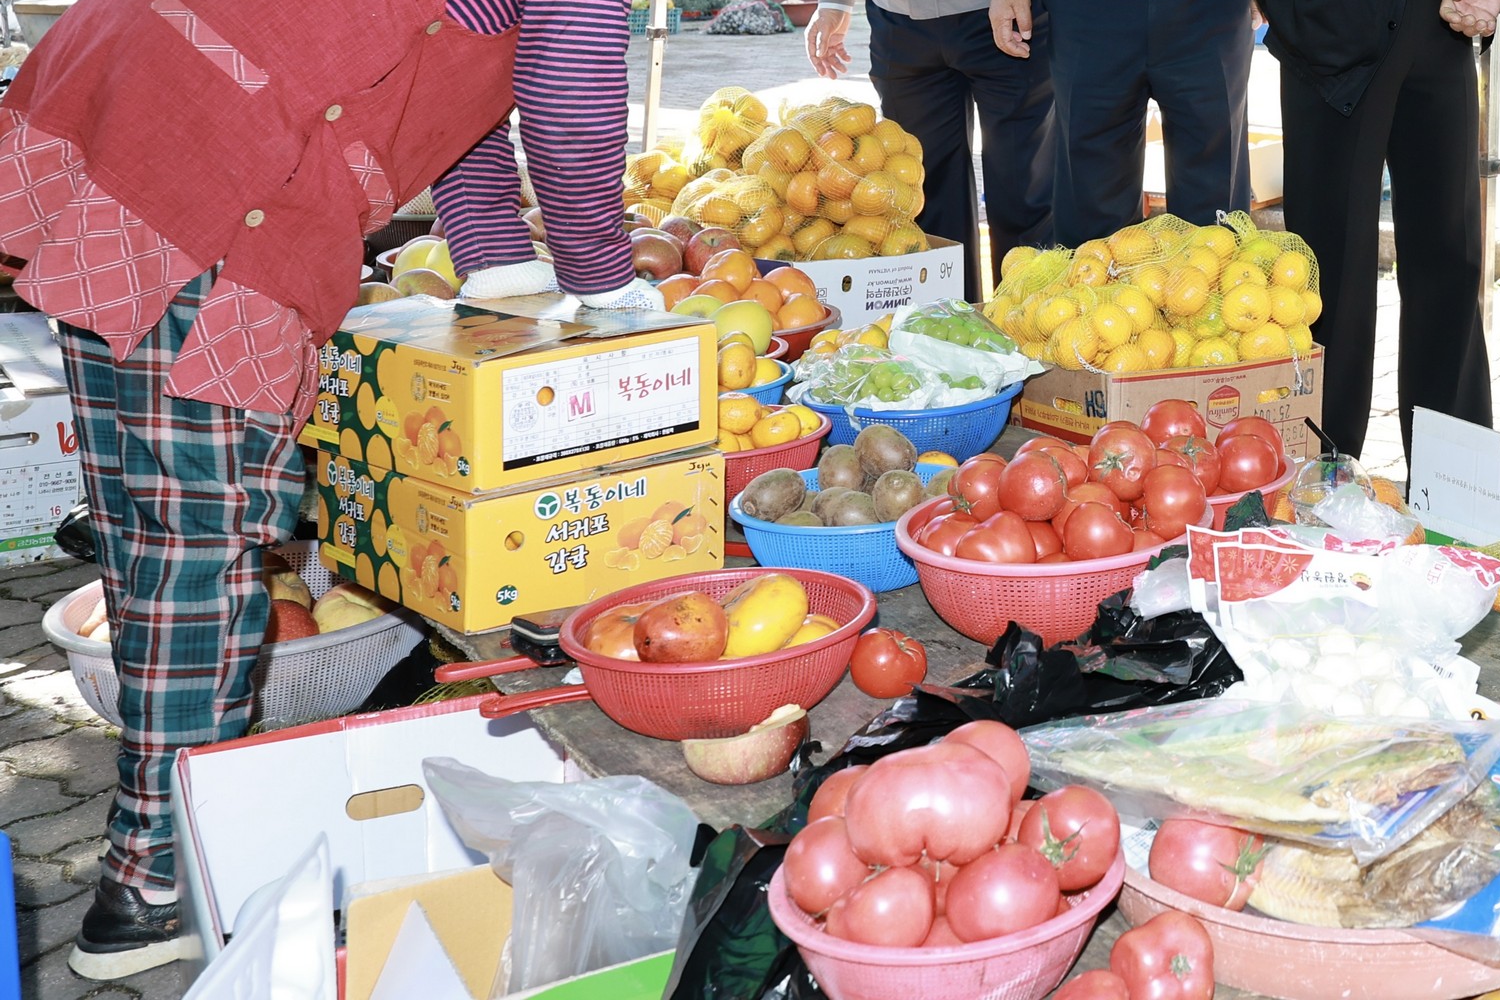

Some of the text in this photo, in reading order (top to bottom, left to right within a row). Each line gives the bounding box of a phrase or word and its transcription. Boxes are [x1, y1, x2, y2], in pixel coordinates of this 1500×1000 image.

[867, 276, 912, 287] www.jinwon.kr
[940, 262, 953, 279] A6
[866, 285, 913, 299] (주)진원무역
[320, 345, 361, 375] 복동이네
[319, 375, 349, 397] 서귀포
[618, 367, 691, 401] 복동이네
[319, 400, 340, 424] 감귤
[569, 392, 592, 416] M
[1209, 406, 1238, 419] Sumifru
[457, 460, 470, 475] 5kg
[338, 466, 374, 500] 복동이네
[564, 477, 648, 513] 복동이네
[50, 505, 61, 517] 16
[339, 496, 365, 522] 서귀포
[338, 521, 357, 548] 감귤
[545, 513, 610, 543] 서귀포
[545, 544, 589, 575] 감귤
[450, 595, 461, 608] 5kg
[496, 588, 519, 603] 5kg
